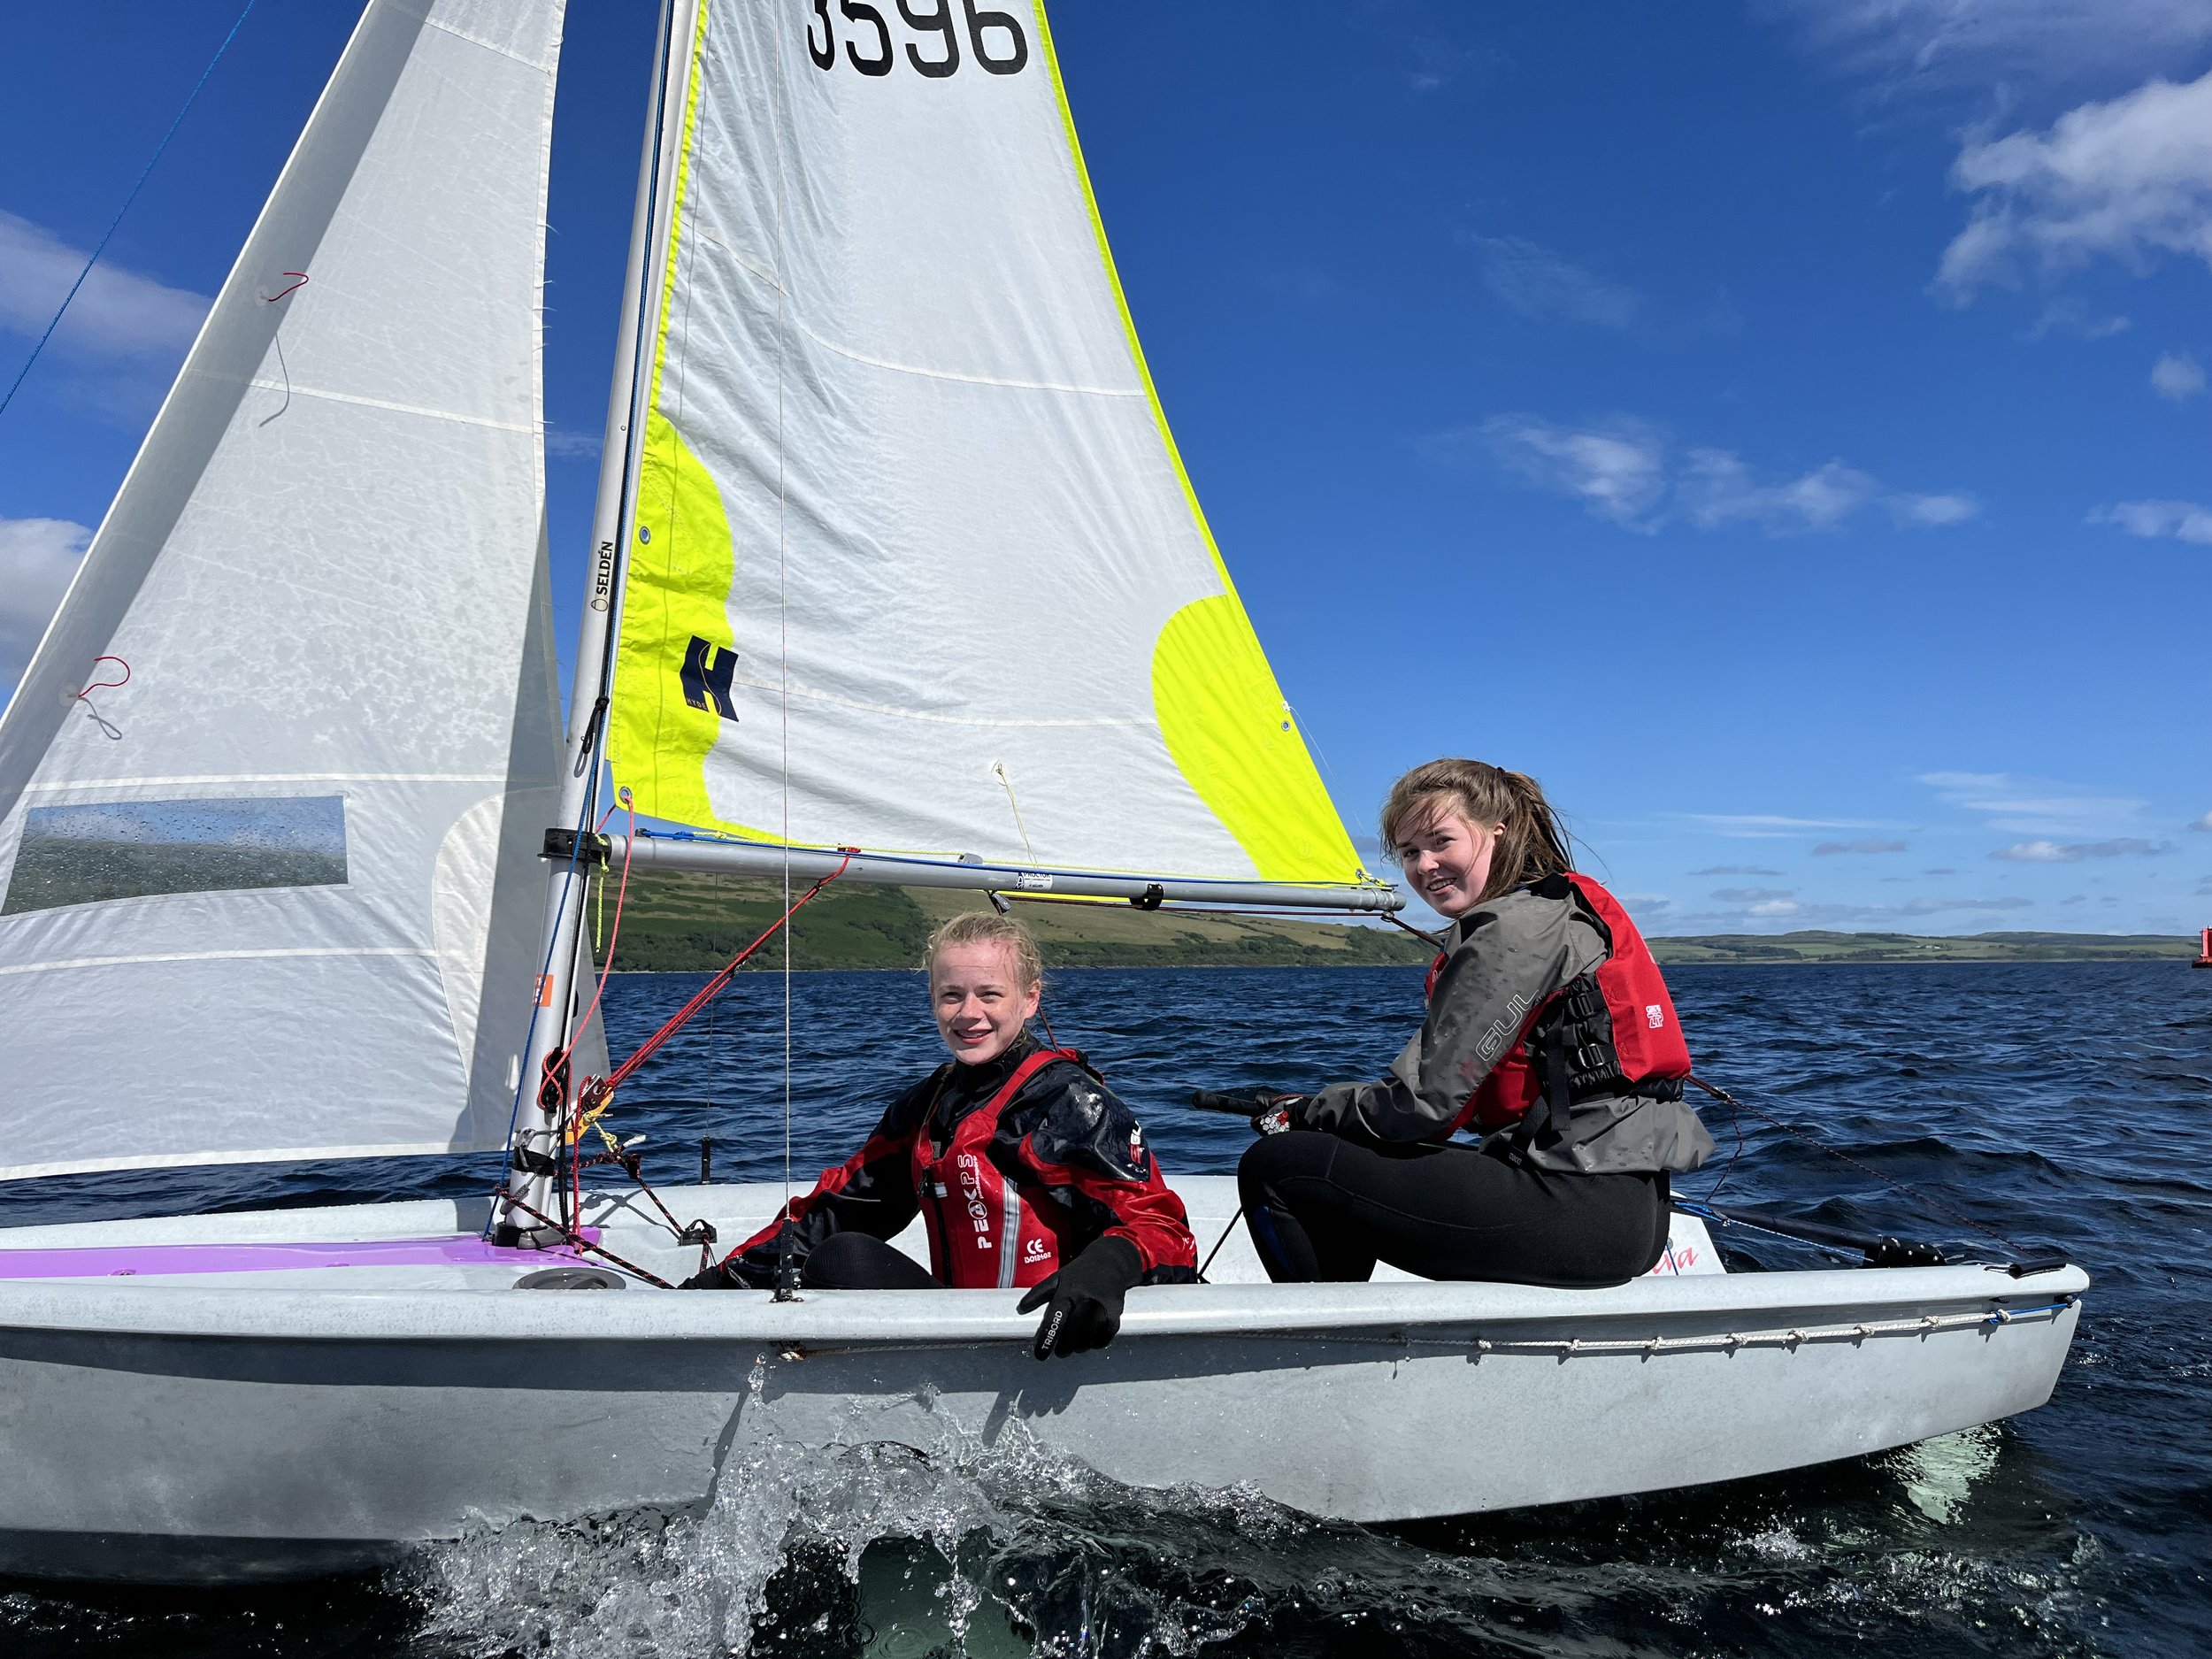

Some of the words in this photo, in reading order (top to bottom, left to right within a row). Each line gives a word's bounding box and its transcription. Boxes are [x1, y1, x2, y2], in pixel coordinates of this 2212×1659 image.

[807, 0, 1028, 78] 3596
[596, 541, 613, 595] SELDÉN
[1476, 989, 1540, 1062] GUL
[1041, 1310, 1063, 1349] TRIBORD
